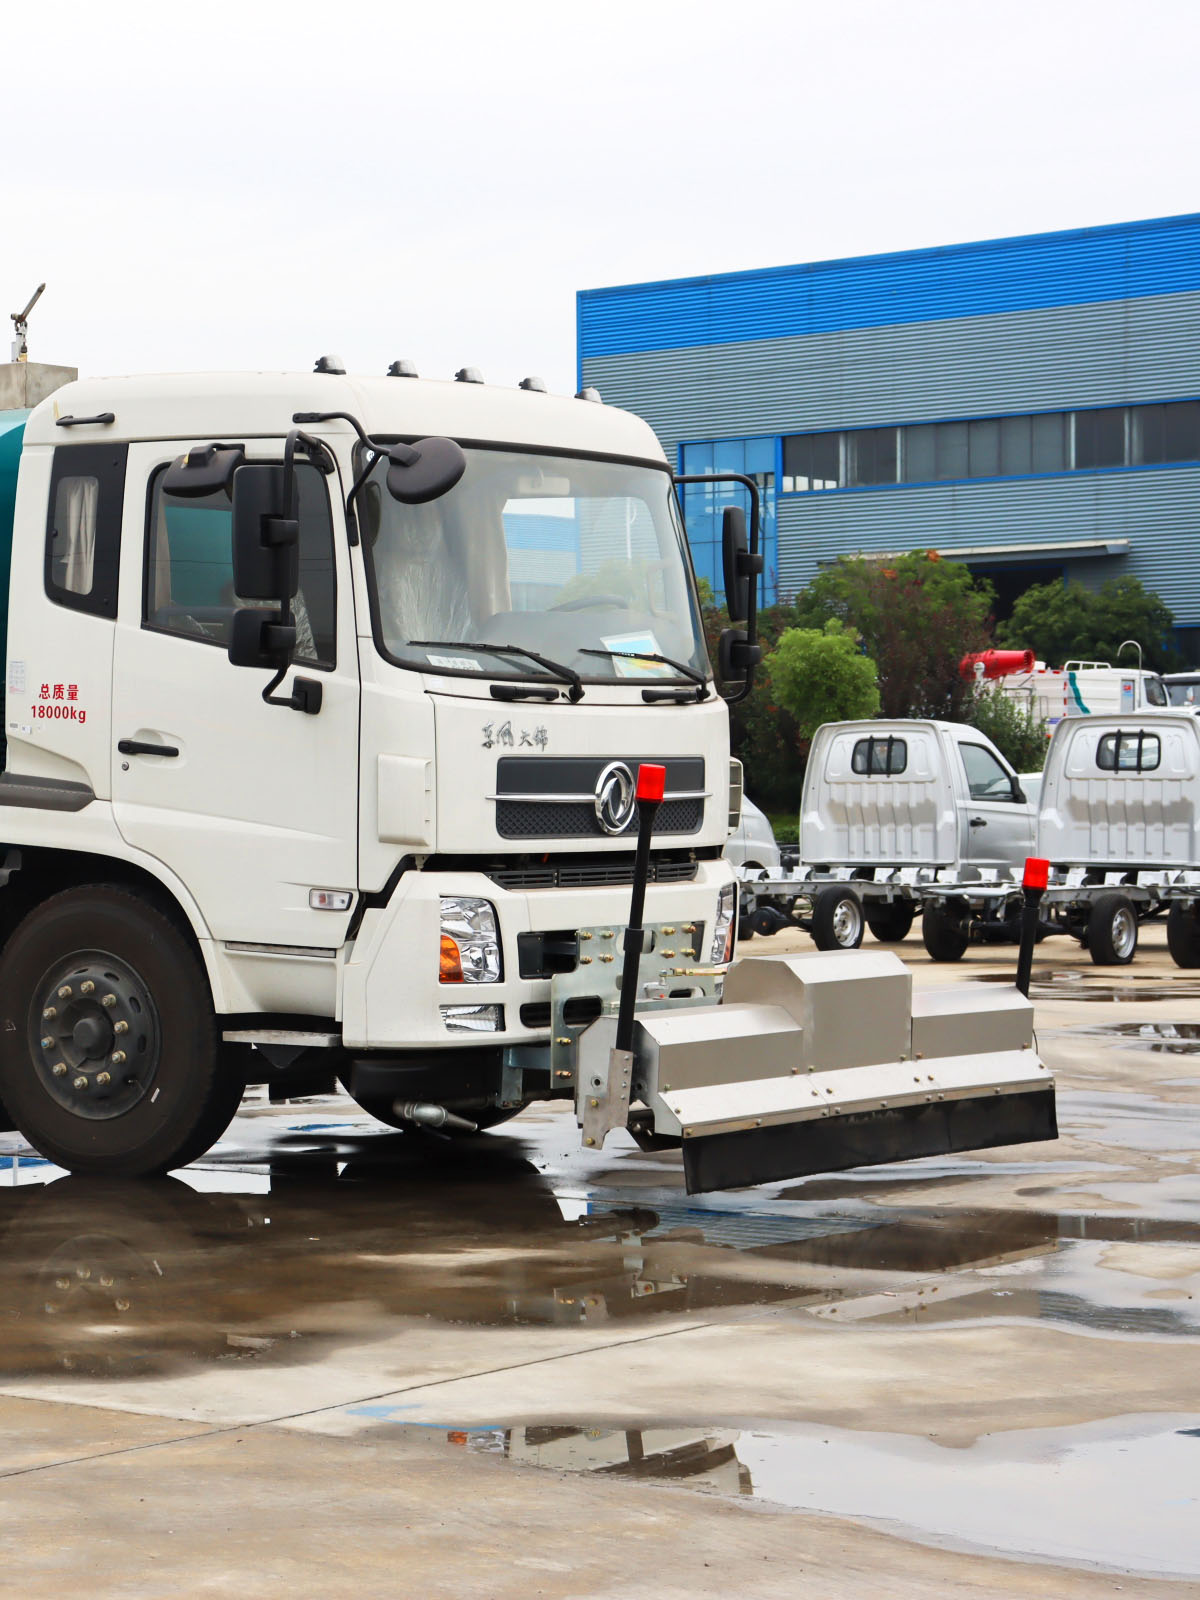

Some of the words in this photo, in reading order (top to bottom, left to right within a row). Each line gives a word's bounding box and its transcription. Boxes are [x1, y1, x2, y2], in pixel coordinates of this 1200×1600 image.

[38, 683, 79, 701] 总质量
[31, 705, 87, 724] 18000kg
